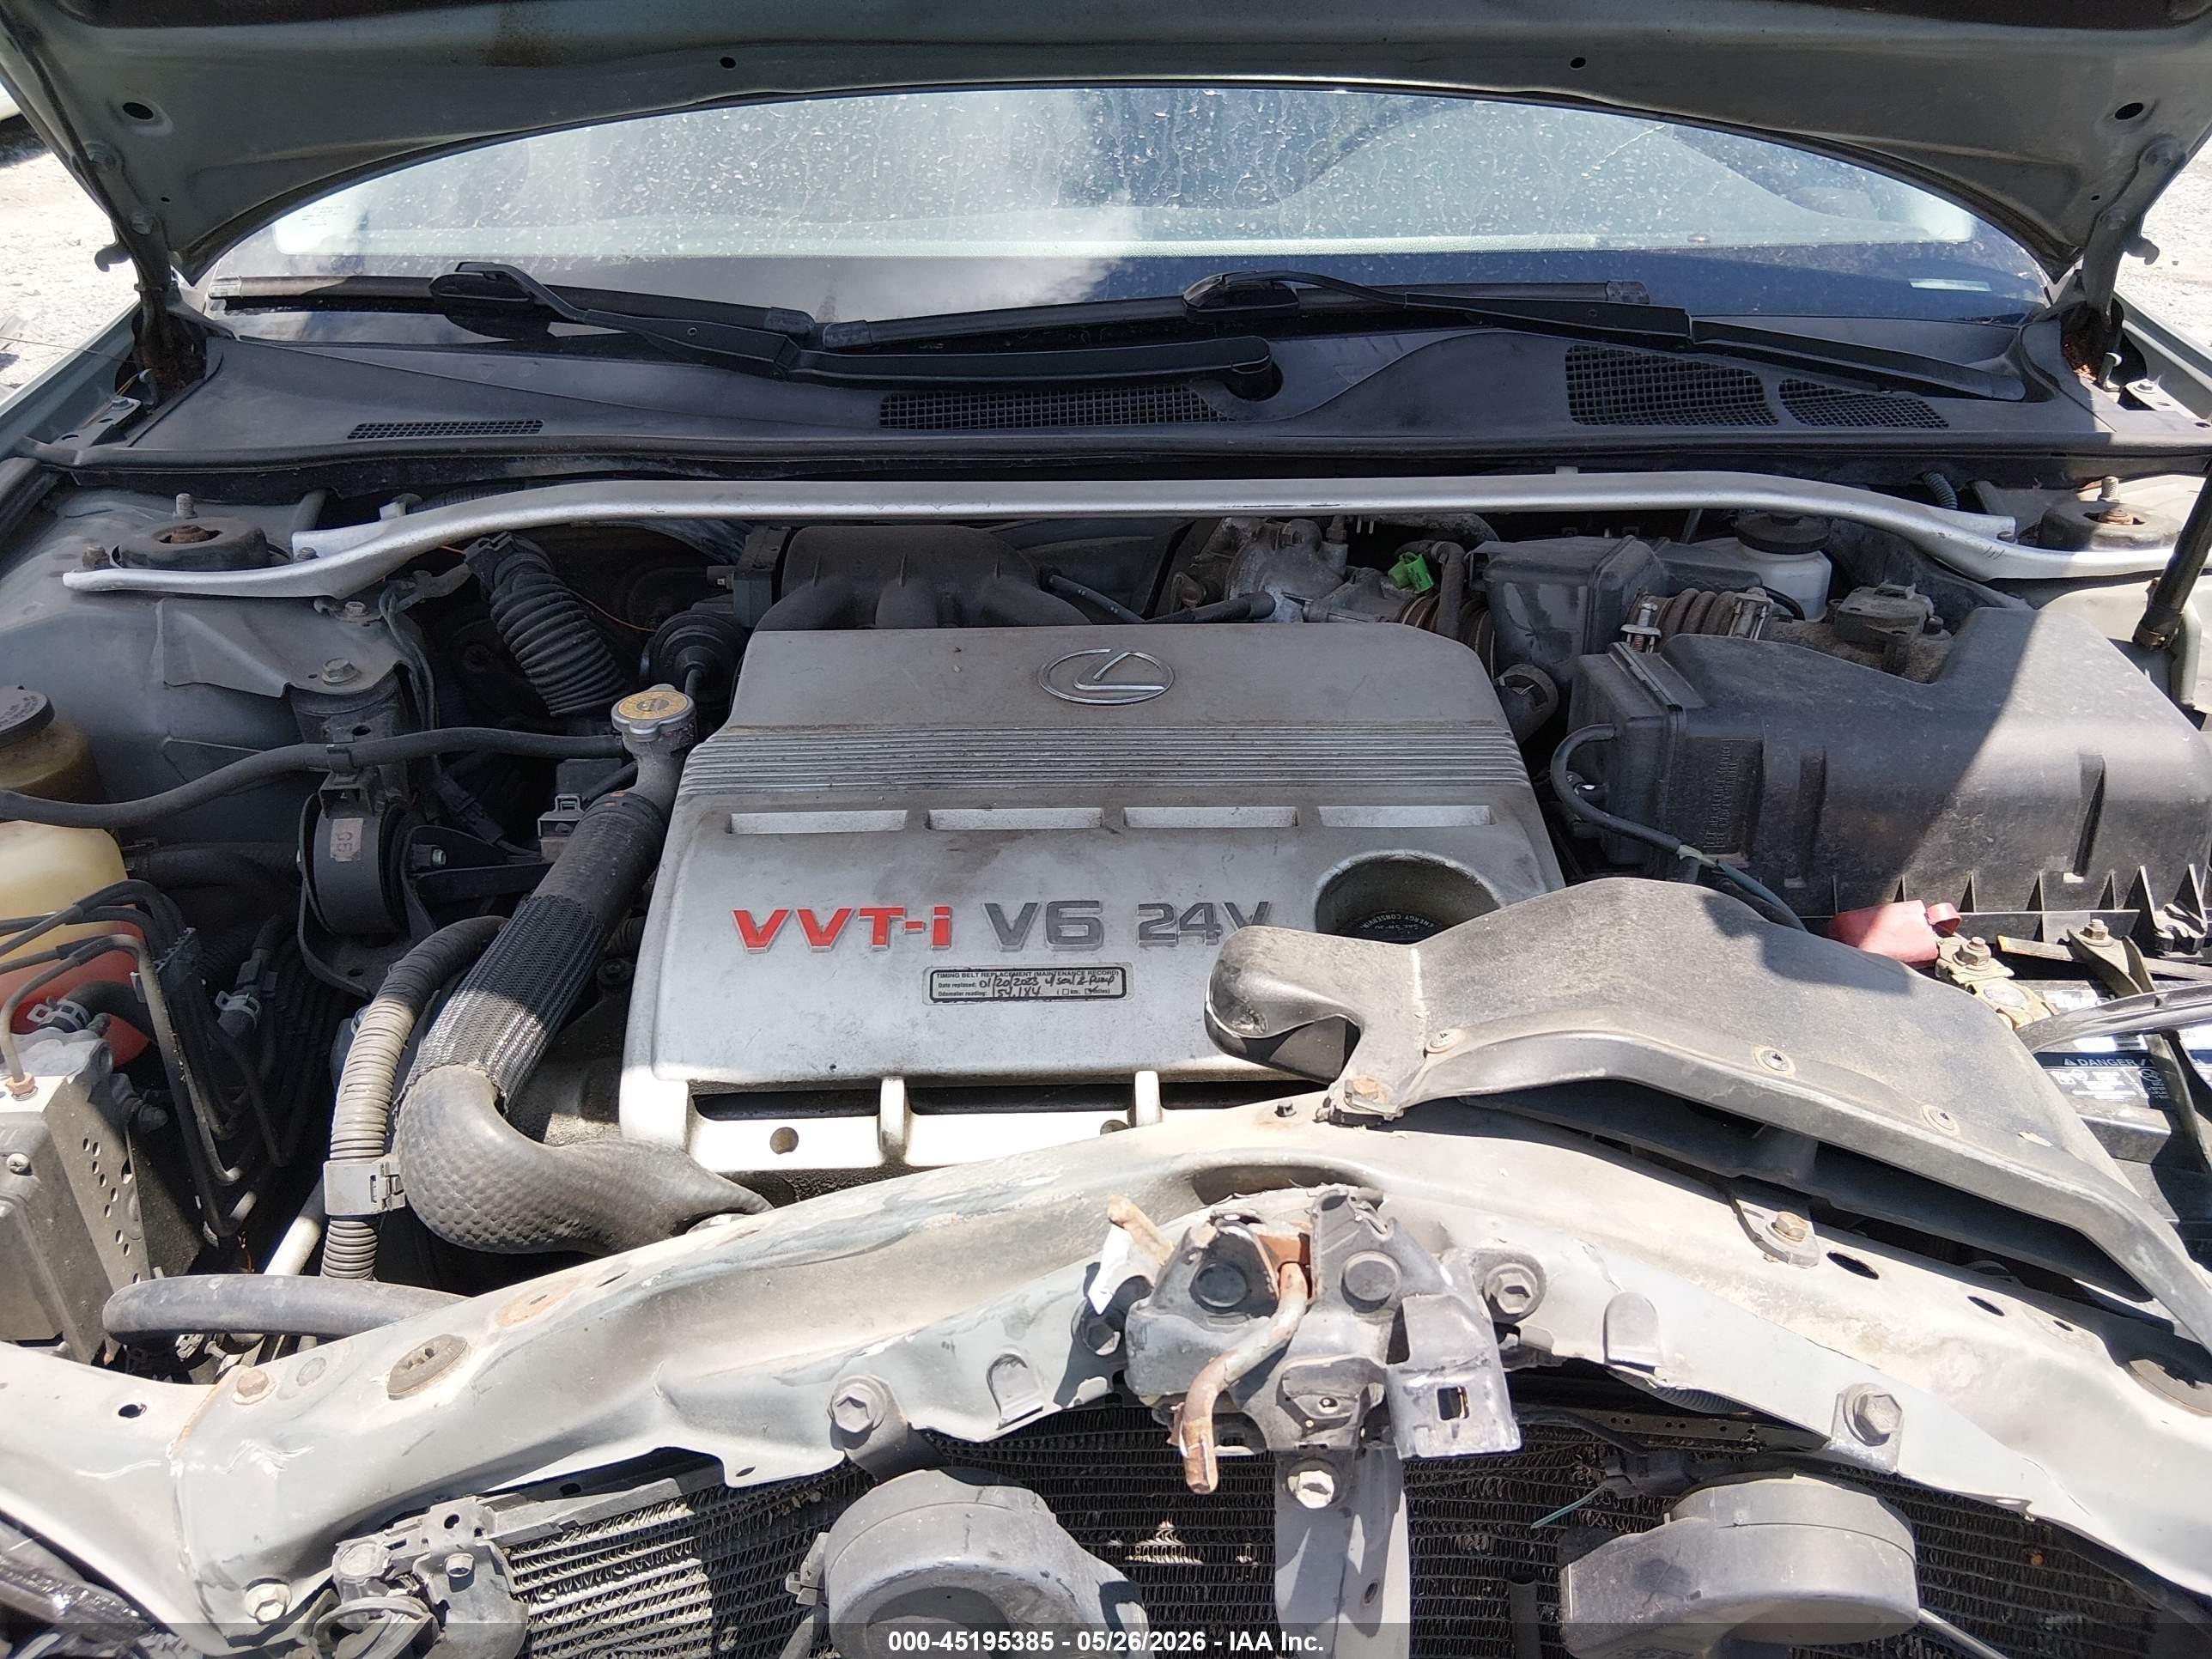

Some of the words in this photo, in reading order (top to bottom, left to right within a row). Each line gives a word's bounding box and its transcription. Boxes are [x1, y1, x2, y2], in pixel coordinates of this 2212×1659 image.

[732, 906, 952, 953] VVT-i
[982, 900, 1104, 951] V6
[1137, 901, 1271, 946] 24V
[2077, 1058, 2137, 1066] DANGER
